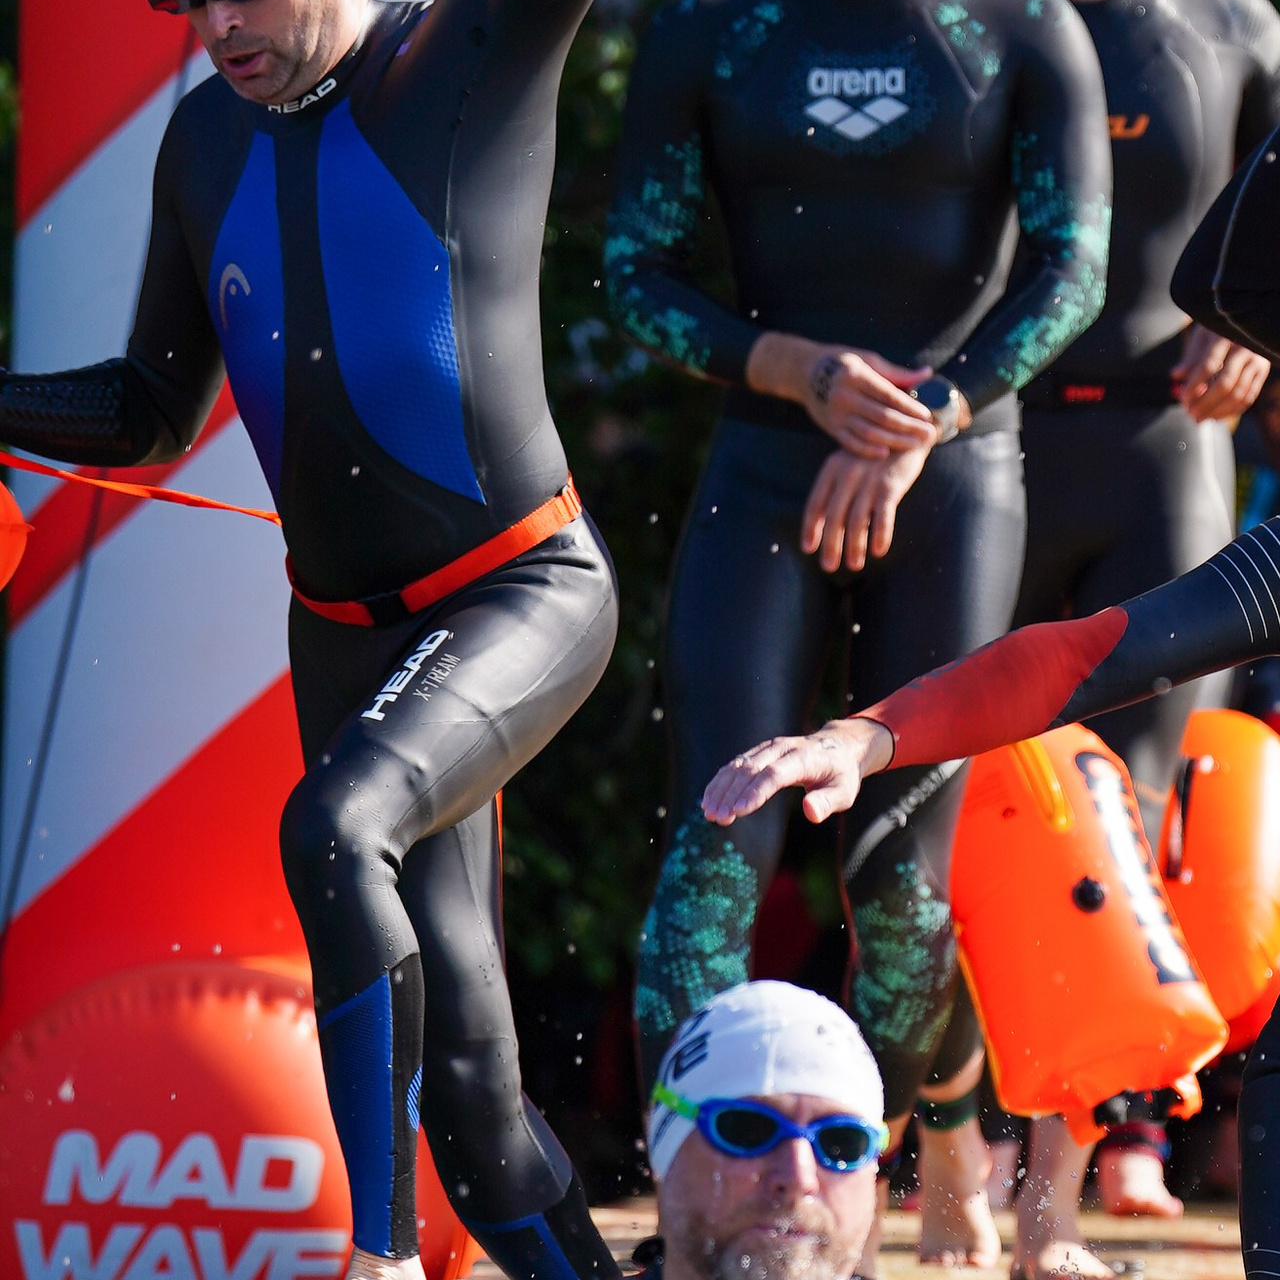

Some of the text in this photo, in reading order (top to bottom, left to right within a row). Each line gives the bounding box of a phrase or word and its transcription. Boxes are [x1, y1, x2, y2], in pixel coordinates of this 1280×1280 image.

[807, 67, 906, 96] arena
[361, 630, 449, 721] HEAD
[413, 653, 460, 701] X-TREAM
[42, 1129, 325, 1213] MAD
